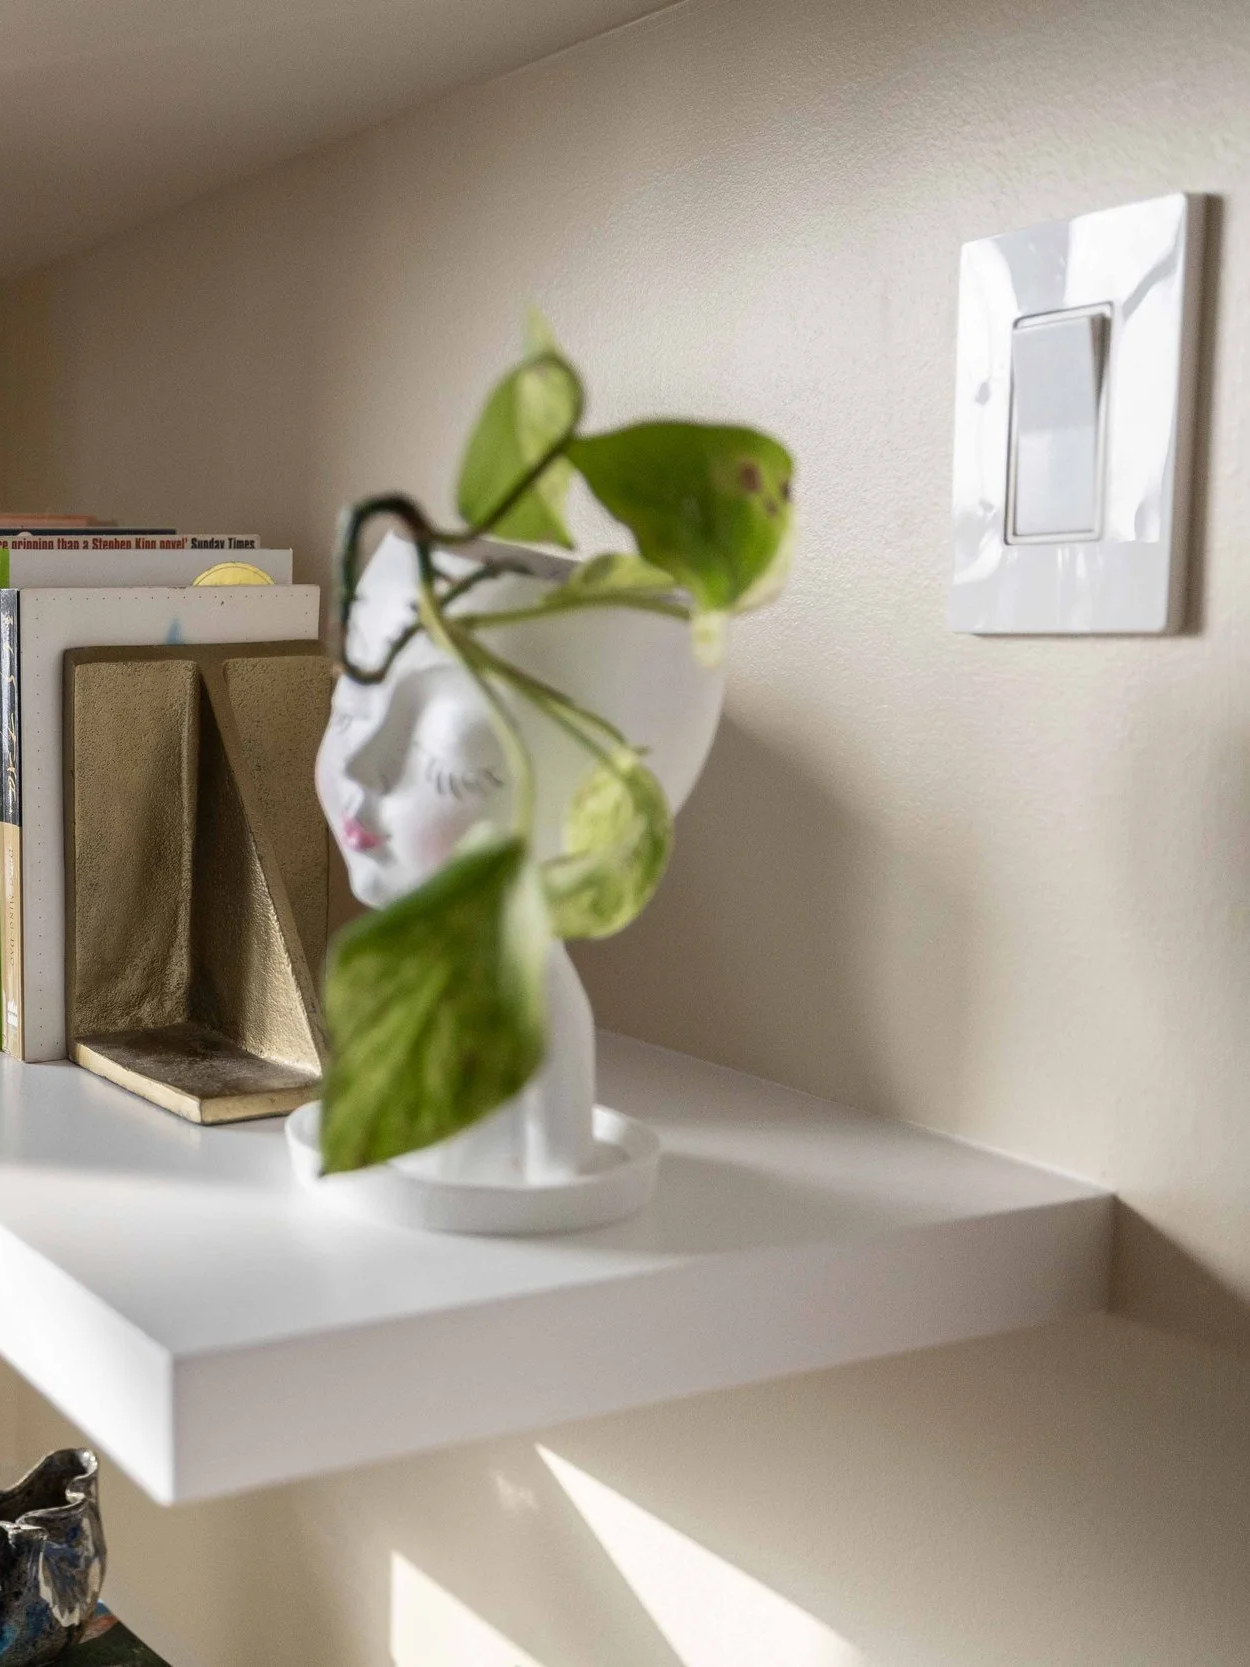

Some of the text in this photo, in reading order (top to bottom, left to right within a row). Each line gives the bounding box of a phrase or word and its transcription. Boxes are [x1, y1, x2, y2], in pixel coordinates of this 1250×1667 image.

[57, 538, 80, 549] than
[83, 541, 88, 549] a
[92, 538, 131, 549] Stephen
[135, 538, 156, 549] King
[191, 538, 224, 549] Sunday
[228, 538, 255, 549] Times
